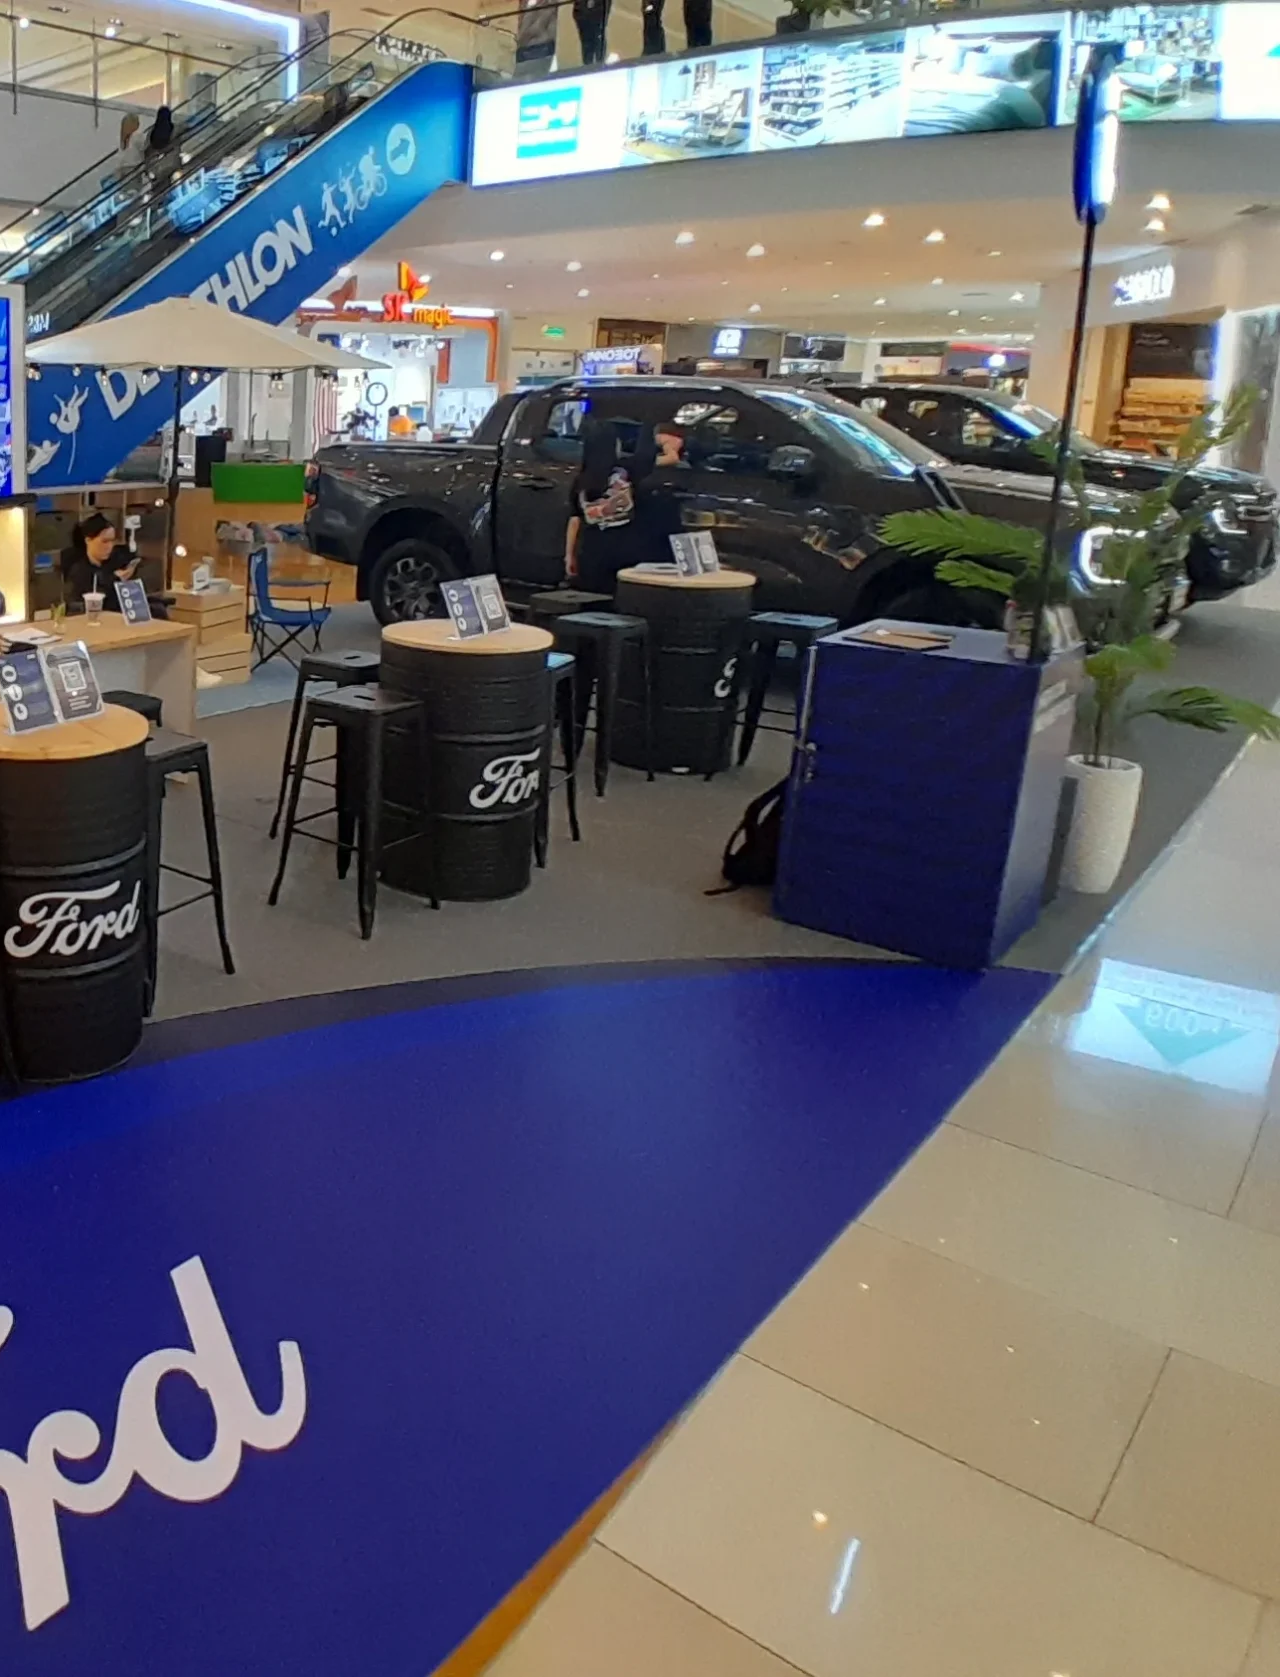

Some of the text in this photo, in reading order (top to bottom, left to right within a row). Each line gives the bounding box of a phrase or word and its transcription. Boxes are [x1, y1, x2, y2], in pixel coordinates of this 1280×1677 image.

[412, 303, 454, 330] magic
[469, 747, 541, 809] For
[4, 880, 141, 958] Ford
